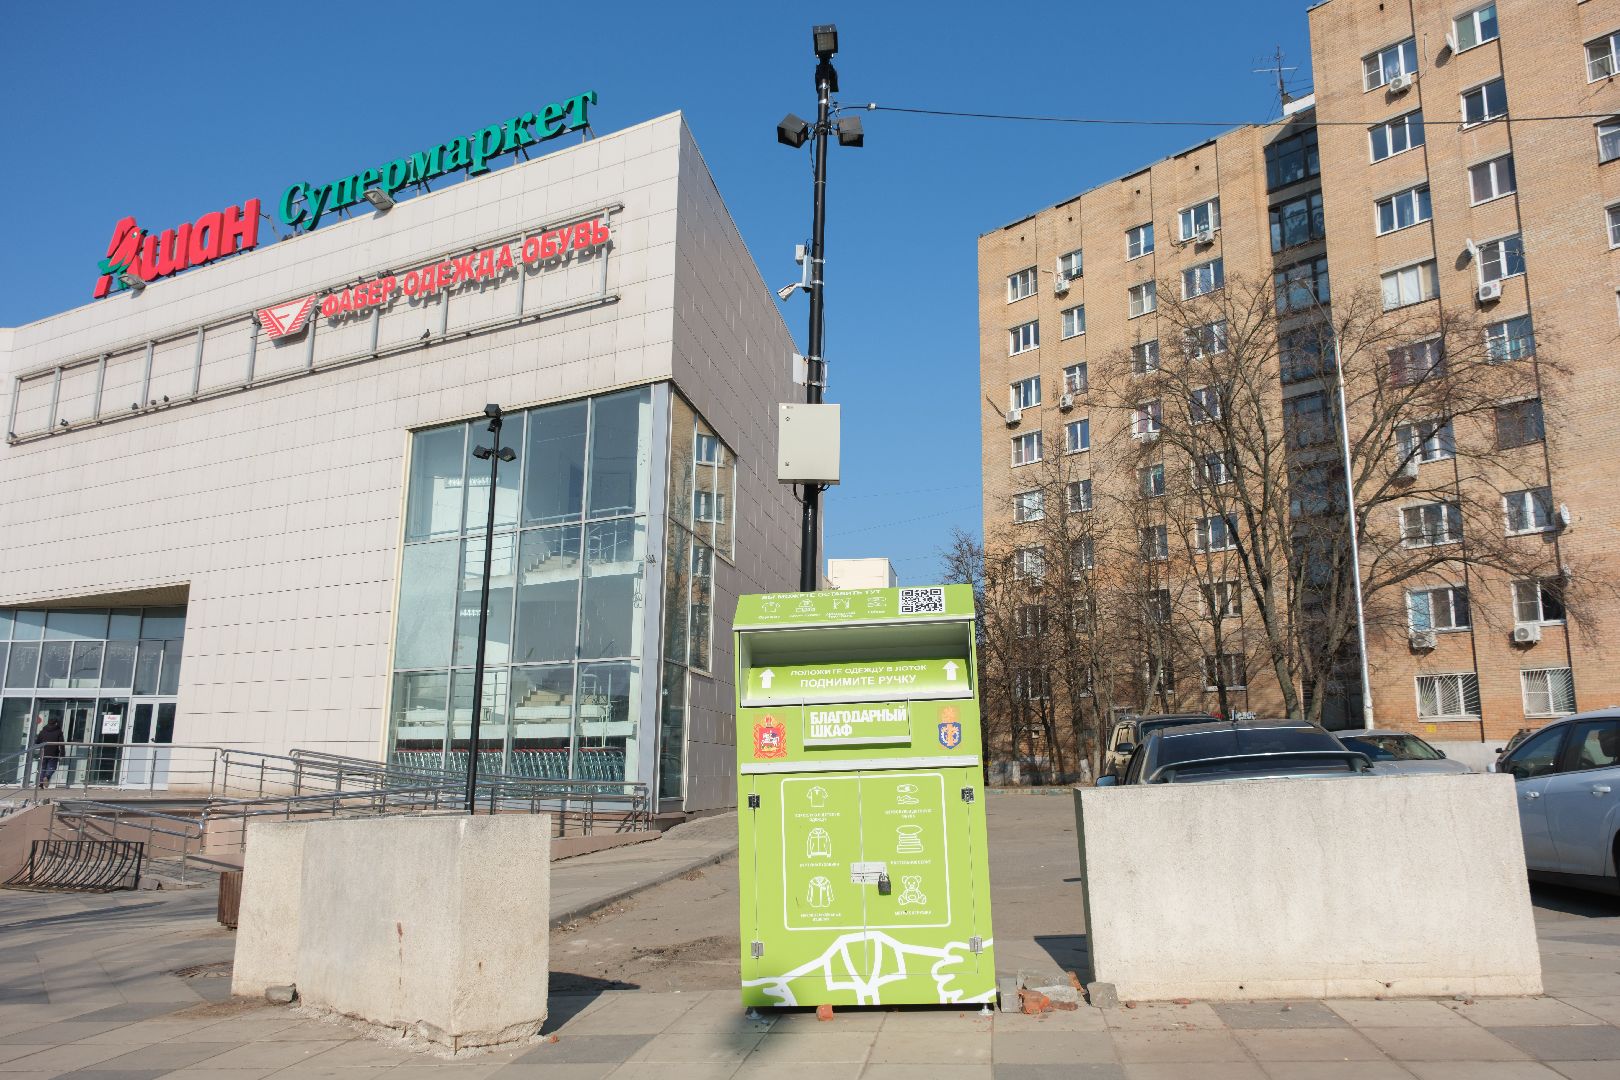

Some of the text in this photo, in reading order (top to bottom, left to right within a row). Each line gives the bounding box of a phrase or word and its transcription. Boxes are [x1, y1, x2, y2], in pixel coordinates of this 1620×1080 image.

[279, 90, 597, 230] Супермаркет
[321, 219, 610, 318] ФАБЕР ОДЕЖДА ОБУВЬ
[791, 668, 843, 676] ПОЛОЖИТЕ
[845, 666, 884, 675] ОДЕЖДУ
[894, 664, 927, 672] ЛОТОК
[800, 674, 917, 689] ПОДНИМИТЕ РУЧКУ
[810, 705, 907, 725] БЛАГОДАРНЫЙ
[810, 724, 853, 738] ШКАФ
